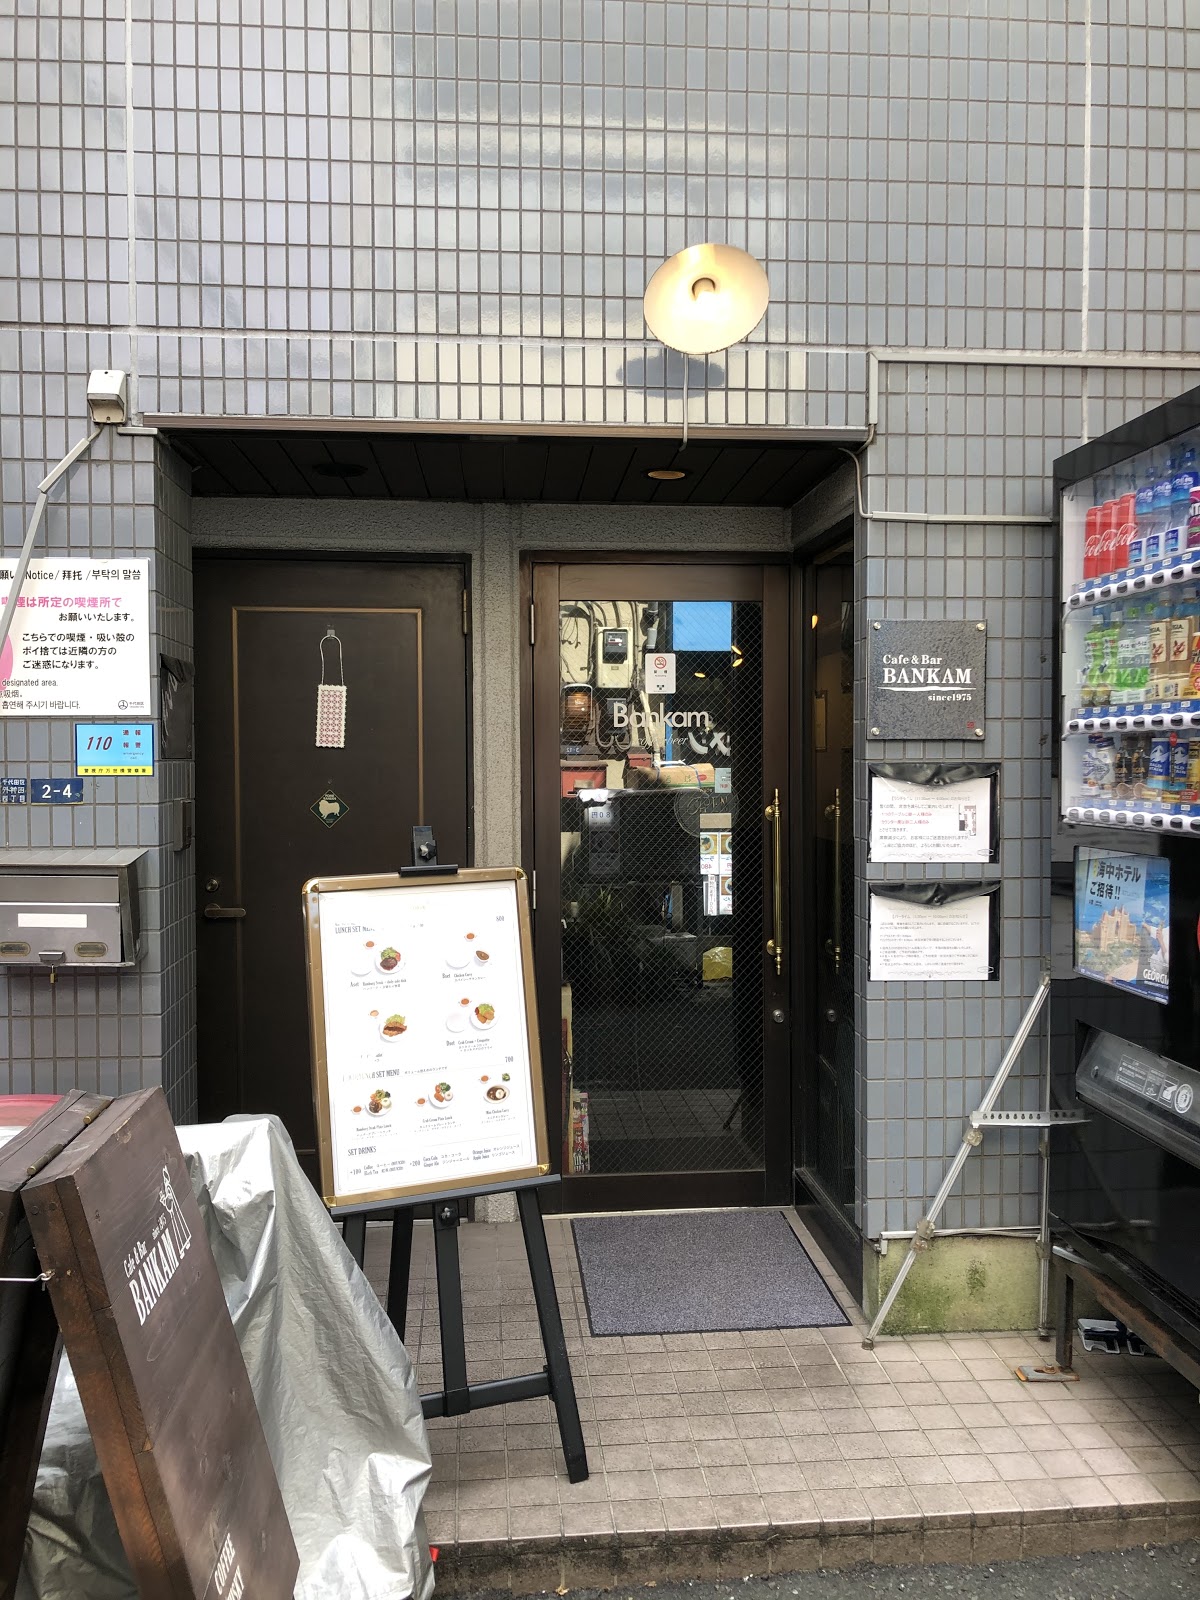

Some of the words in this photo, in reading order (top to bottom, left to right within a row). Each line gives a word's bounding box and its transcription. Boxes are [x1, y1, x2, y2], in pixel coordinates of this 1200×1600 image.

[122, 569, 142, 581] 말씀
[58, 612, 134, 622] お願いいたします。
[22, 646, 117, 656] ポイ捨ては近隣の方の
[22, 660, 99, 670] ご迷惑になります。
[882, 654, 909, 665] Cafe
[911, 655, 919, 665] &
[921, 655, 943, 665] Bar
[882, 667, 972, 684] BANKAM
[1, 679, 39, 687] designated
[26, 700, 48, 710] 주시기
[50, 700, 81, 710] 바랍니다.
[613, 702, 709, 728] Bankam
[86, 736, 113, 750] 110
[2, 786, 25, 794] 外神田
[42, 784, 72, 799] 2-4
[1096, 861, 1141, 883] 海中ホテル
[347, 1147, 357, 1156] SET
[129, 1227, 180, 1327] BANKAM
[214, 1532, 236, 1596] COFFEE
